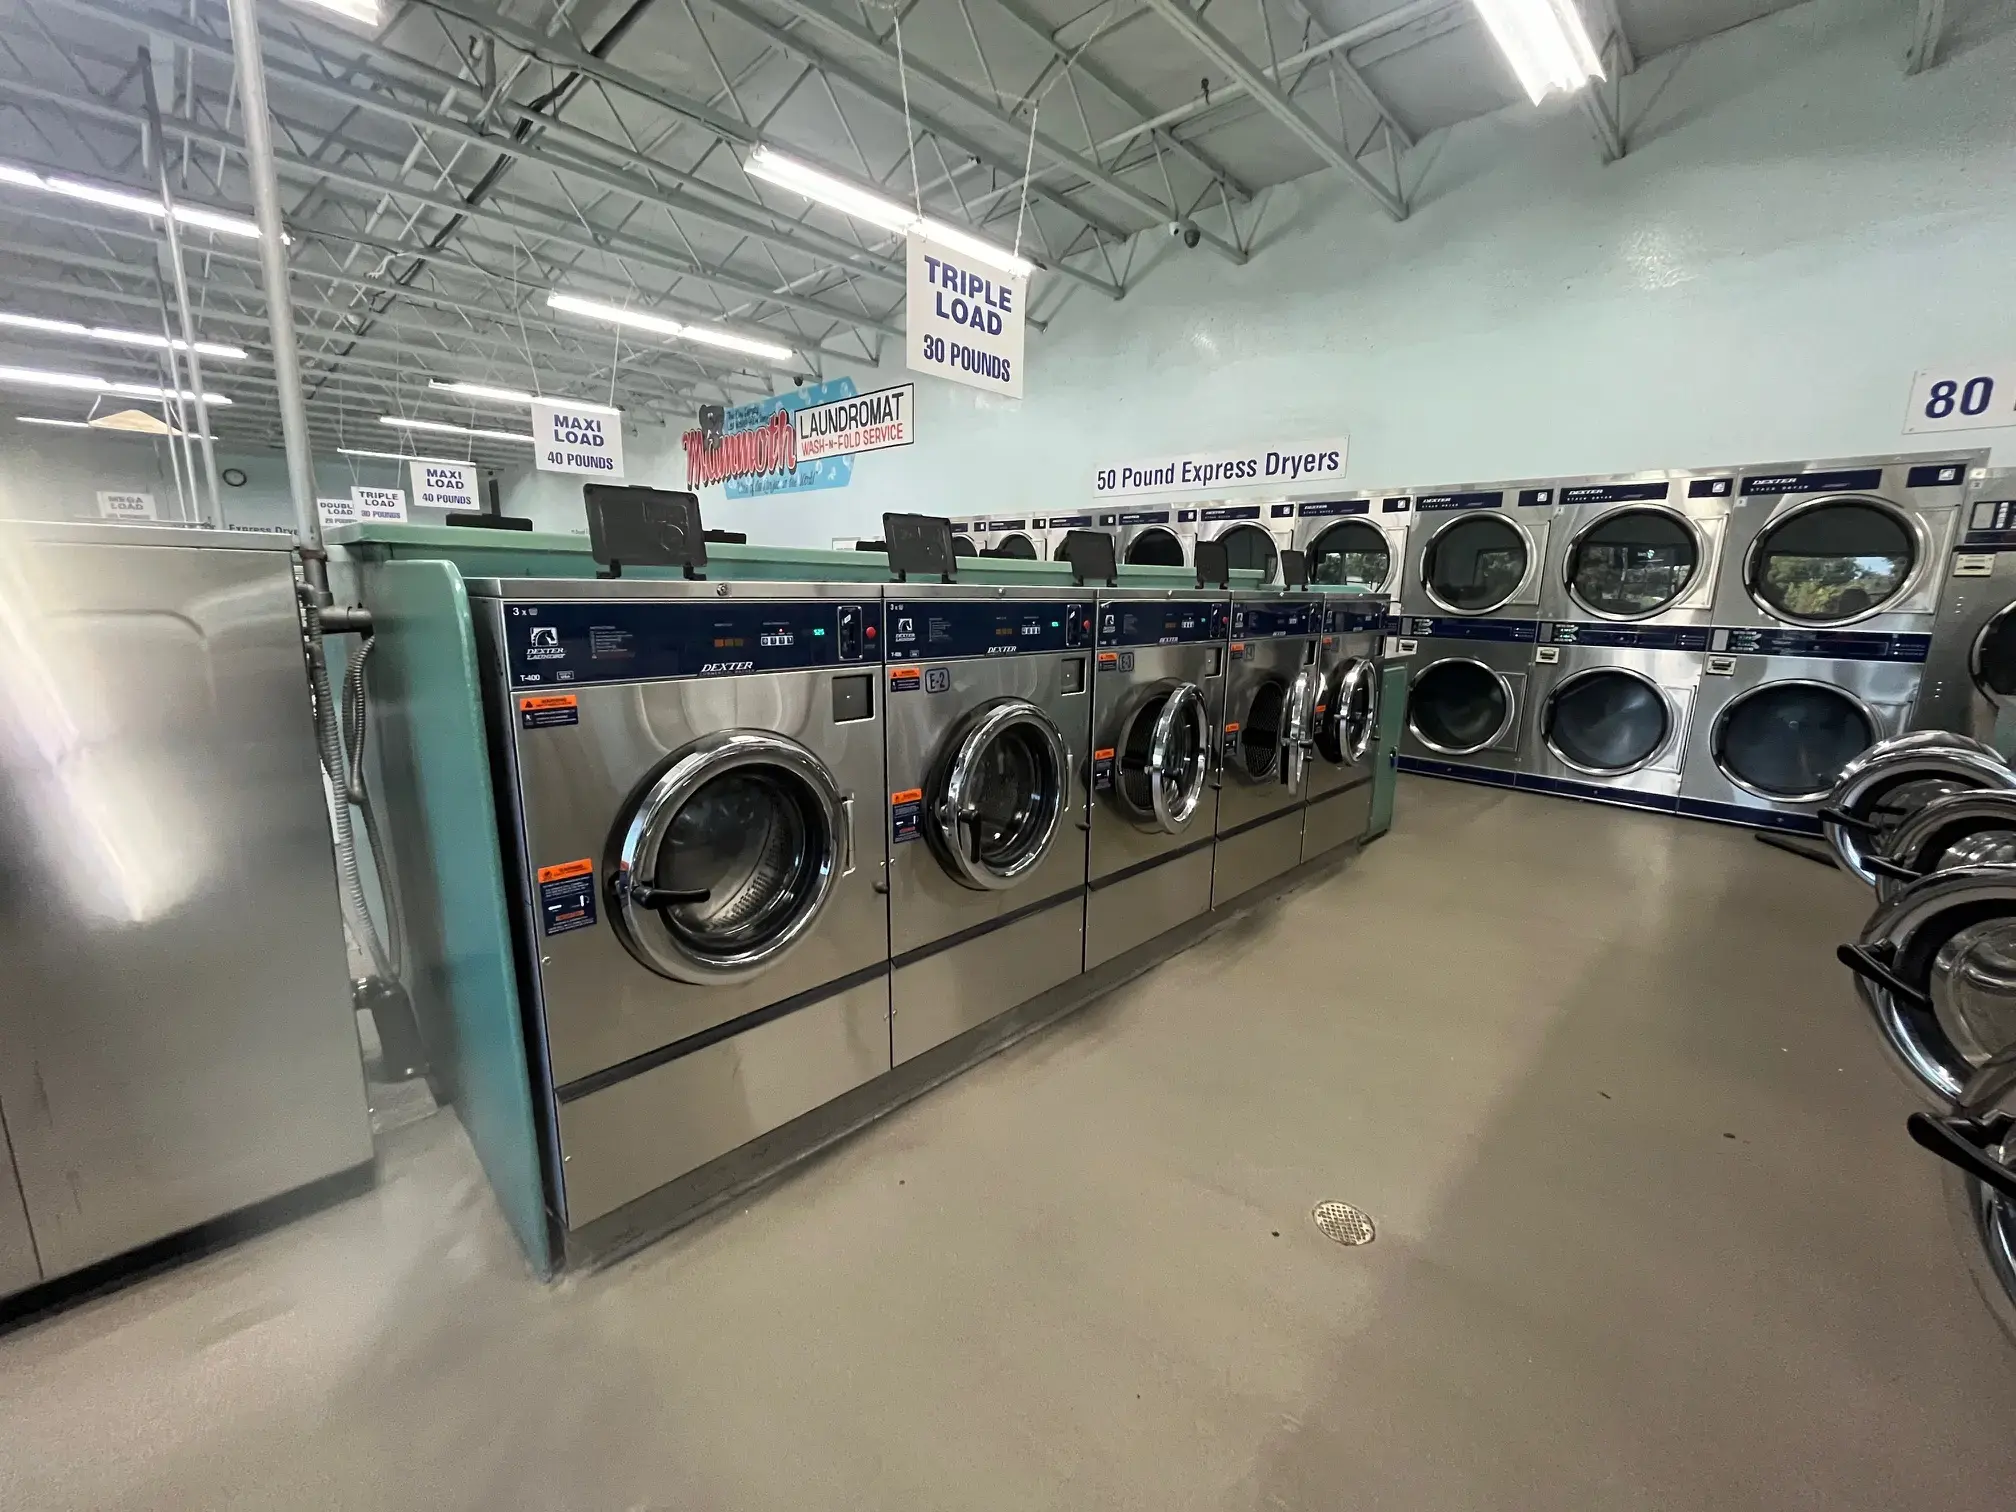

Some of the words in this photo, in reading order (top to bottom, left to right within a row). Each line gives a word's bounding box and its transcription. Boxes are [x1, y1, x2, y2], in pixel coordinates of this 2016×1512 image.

[924, 254, 1012, 313] TRIPLE
[936, 291, 1003, 336] LOAD
[923, 334, 945, 363] 30
[950, 342, 1011, 382] POUNDS
[1925, 376, 1994, 419] 80
[554, 414, 602, 432] MAXI
[800, 392, 904, 440] LAUNDROMAT
[554, 429, 605, 447] LOAD
[801, 432, 860, 456] WASH-N-FOLD
[863, 423, 904, 446] SERVICE
[682, 408, 797, 491] Mammoth
[547, 451, 563, 465] 40
[567, 453, 613, 470] POUNDS
[426, 468, 462, 480] MAXI
[1097, 468, 1116, 491] 50
[1122, 463, 1175, 488] Pound
[1181, 458, 1257, 487] Express
[1264, 450, 1340, 480] Dryers
[426, 479, 464, 490] LOAD
[1752, 477, 1798, 486] DEXTER
[359, 490, 399, 500] TRIPLE
[365, 499, 396, 508] LOAD
[422, 493, 434, 503] 40
[436, 494, 472, 505] POUNDS
[110, 502, 144, 511] LOAD
[512, 607, 520, 616] 3
[700, 661, 754, 673] DEXTER
[520, 673, 541, 682] T-400
[929, 671, 946, 690] E-2
